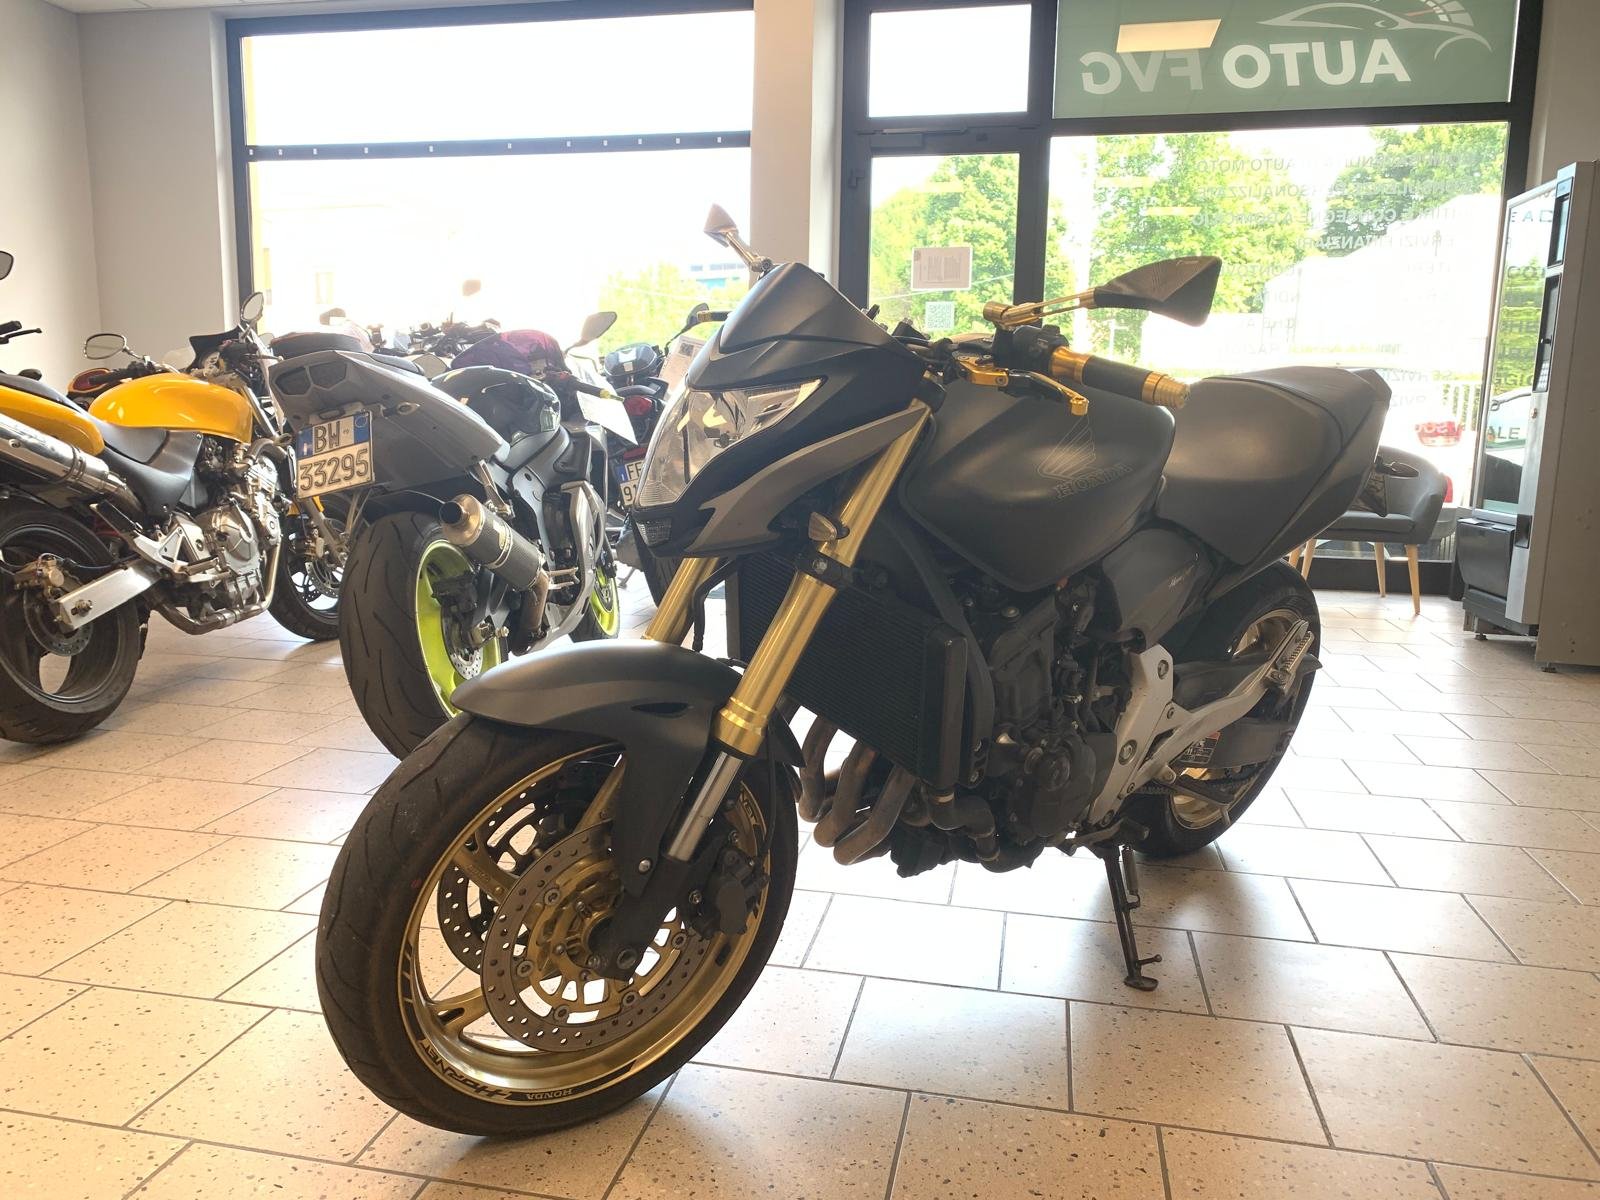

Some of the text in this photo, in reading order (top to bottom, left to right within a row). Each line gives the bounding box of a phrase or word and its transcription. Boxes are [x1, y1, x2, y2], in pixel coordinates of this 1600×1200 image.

[313, 420, 341, 454] BW
[299, 446, 370, 491] 33295
[418, 1040, 512, 1100] HORNET
[525, 1088, 574, 1101] HONDA
